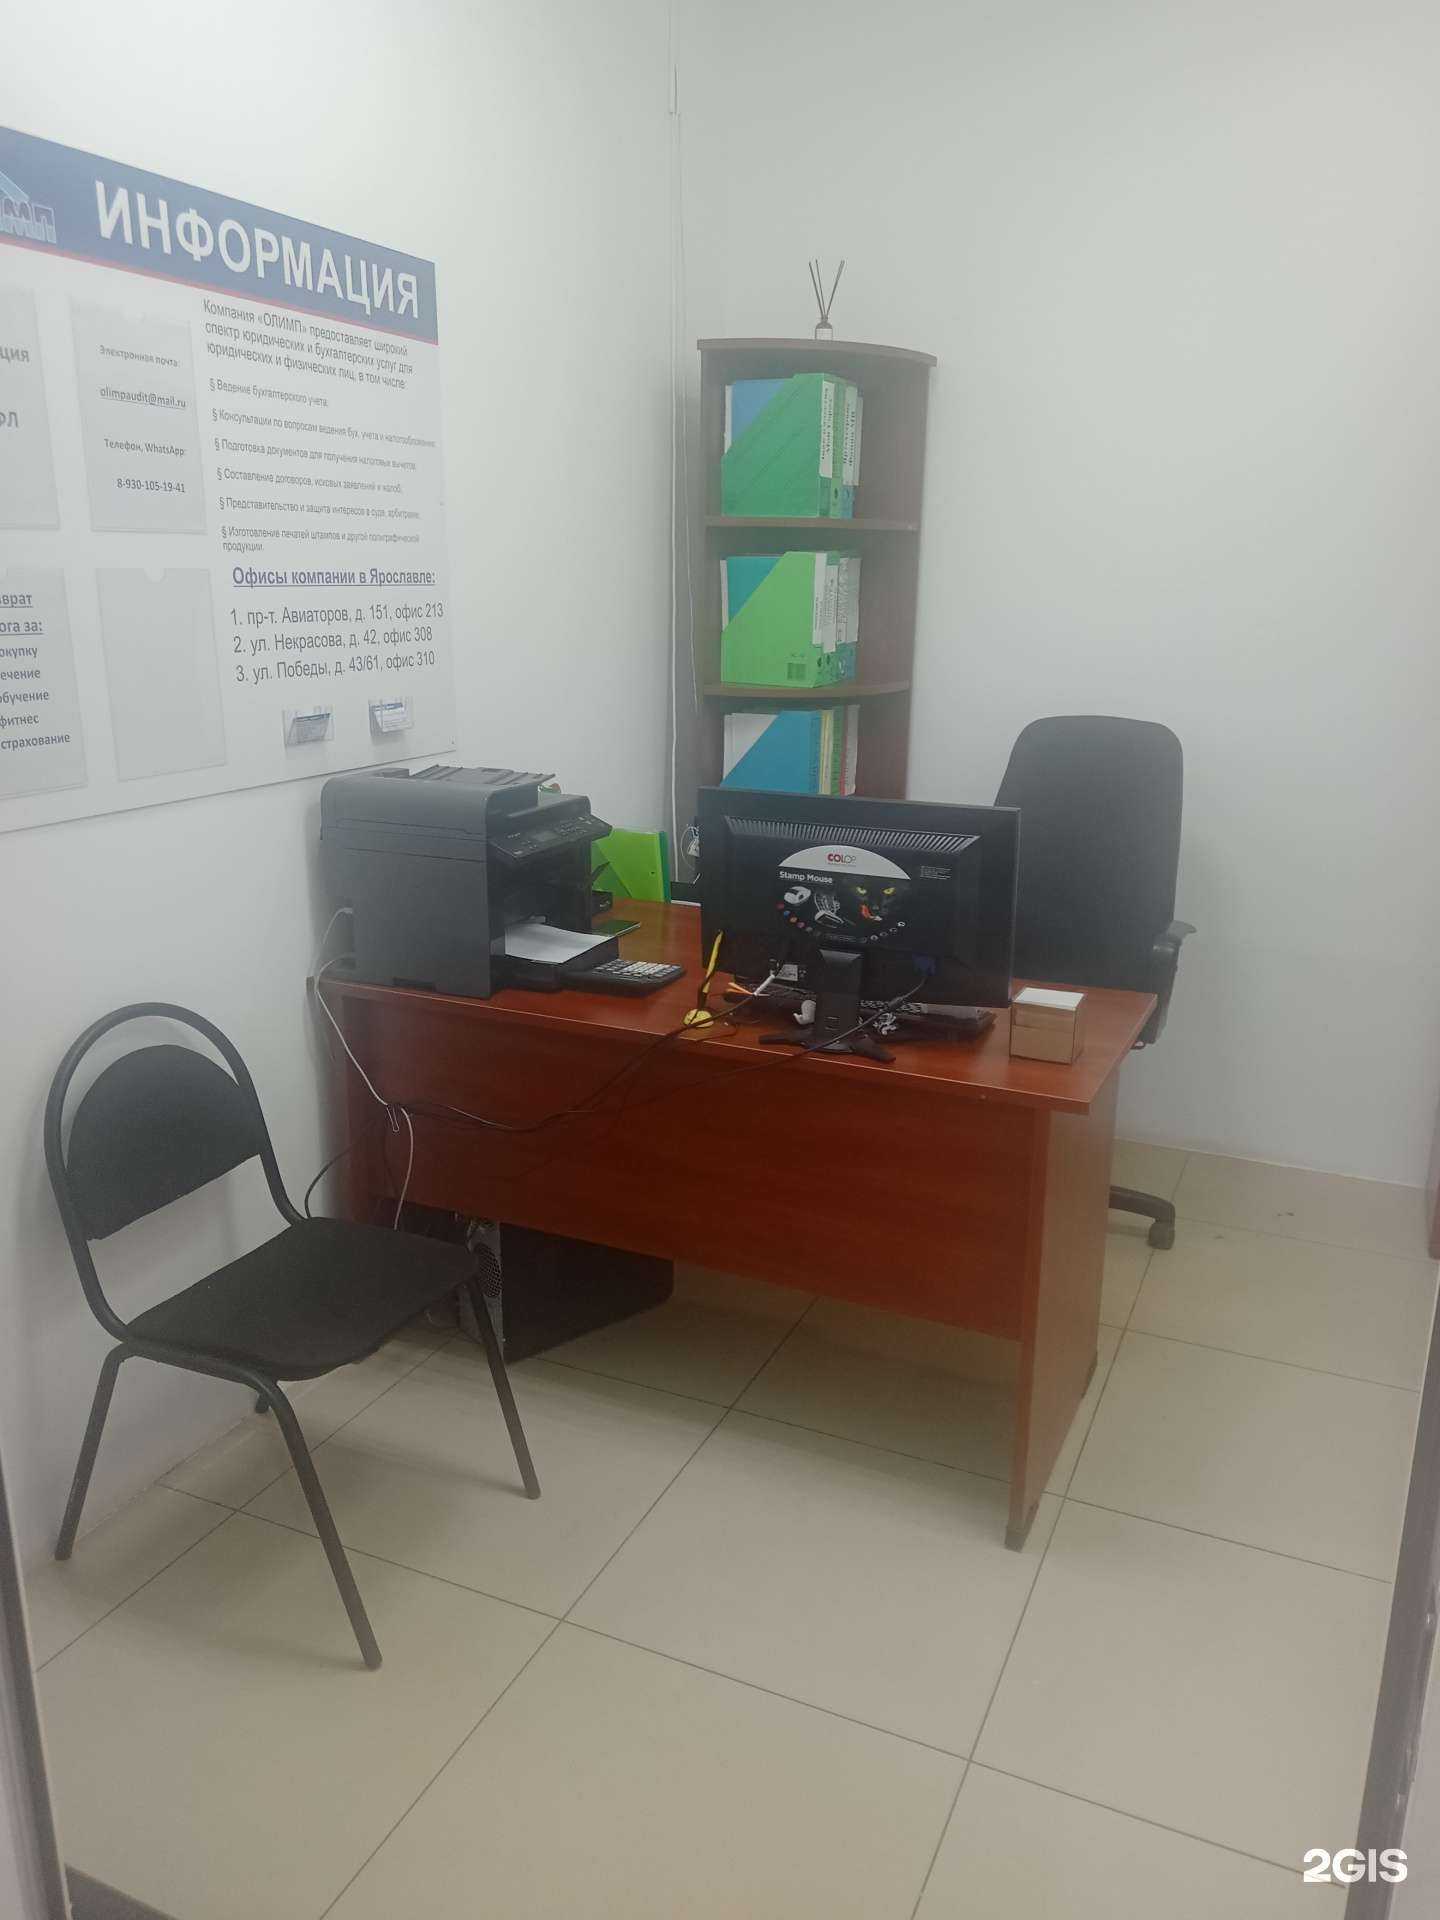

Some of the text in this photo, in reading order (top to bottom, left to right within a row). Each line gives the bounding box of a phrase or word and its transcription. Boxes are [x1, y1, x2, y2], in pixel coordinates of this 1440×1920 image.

[95, 180, 418, 318] ИНФОРМАЦИЯ
[203, 299, 255, 323] Компания
[257, 312, 307, 333] «ОЛИМП»
[309, 326, 372, 348] предоставляет
[100, 344, 154, 363] Электронная
[205, 322, 240, 341] спектр
[242, 330, 305, 353] юридических
[307, 343, 313, 353] и
[315, 342, 374, 365] бухгалтерских
[376, 359, 397, 371] услуг
[207, 343, 273, 366] юридических
[275, 355, 282, 366] и
[284, 355, 337, 377] физических
[358, 371, 364, 382] в
[366, 373, 380, 385] том
[100, 384, 187, 409] olimpaudit@mail.ru
[217, 379, 251, 395] Ведение
[219, 408, 272, 426] Консультации
[273, 418, 283, 428] по
[104, 438, 143, 454] Телефон,
[221, 438, 265, 454] Подготовка
[266, 446, 308, 458] документов
[223, 468, 274, 483] Составление
[116, 478, 186, 493] 8-930-105-19-41
[226, 497, 299, 512] Представительство
[228, 525, 280, 538] Изготовление
[232, 566, 436, 589] Офисы компании в Ярославле:
[0, 593, 33, 608] врат
[230, 602, 444, 629] 1. пр-т. Авиаторов, д. 151, офис 213
[24, 620, 43, 633] за:
[233, 625, 433, 656] 2. ул. Некрасова, д. 42, офис 308
[236, 650, 435, 685] 3. ул. Победы, д. 43/61, офис 310
[0, 733, 71, 751] страхование
[779, 870, 833, 885] Stamp Mouse
